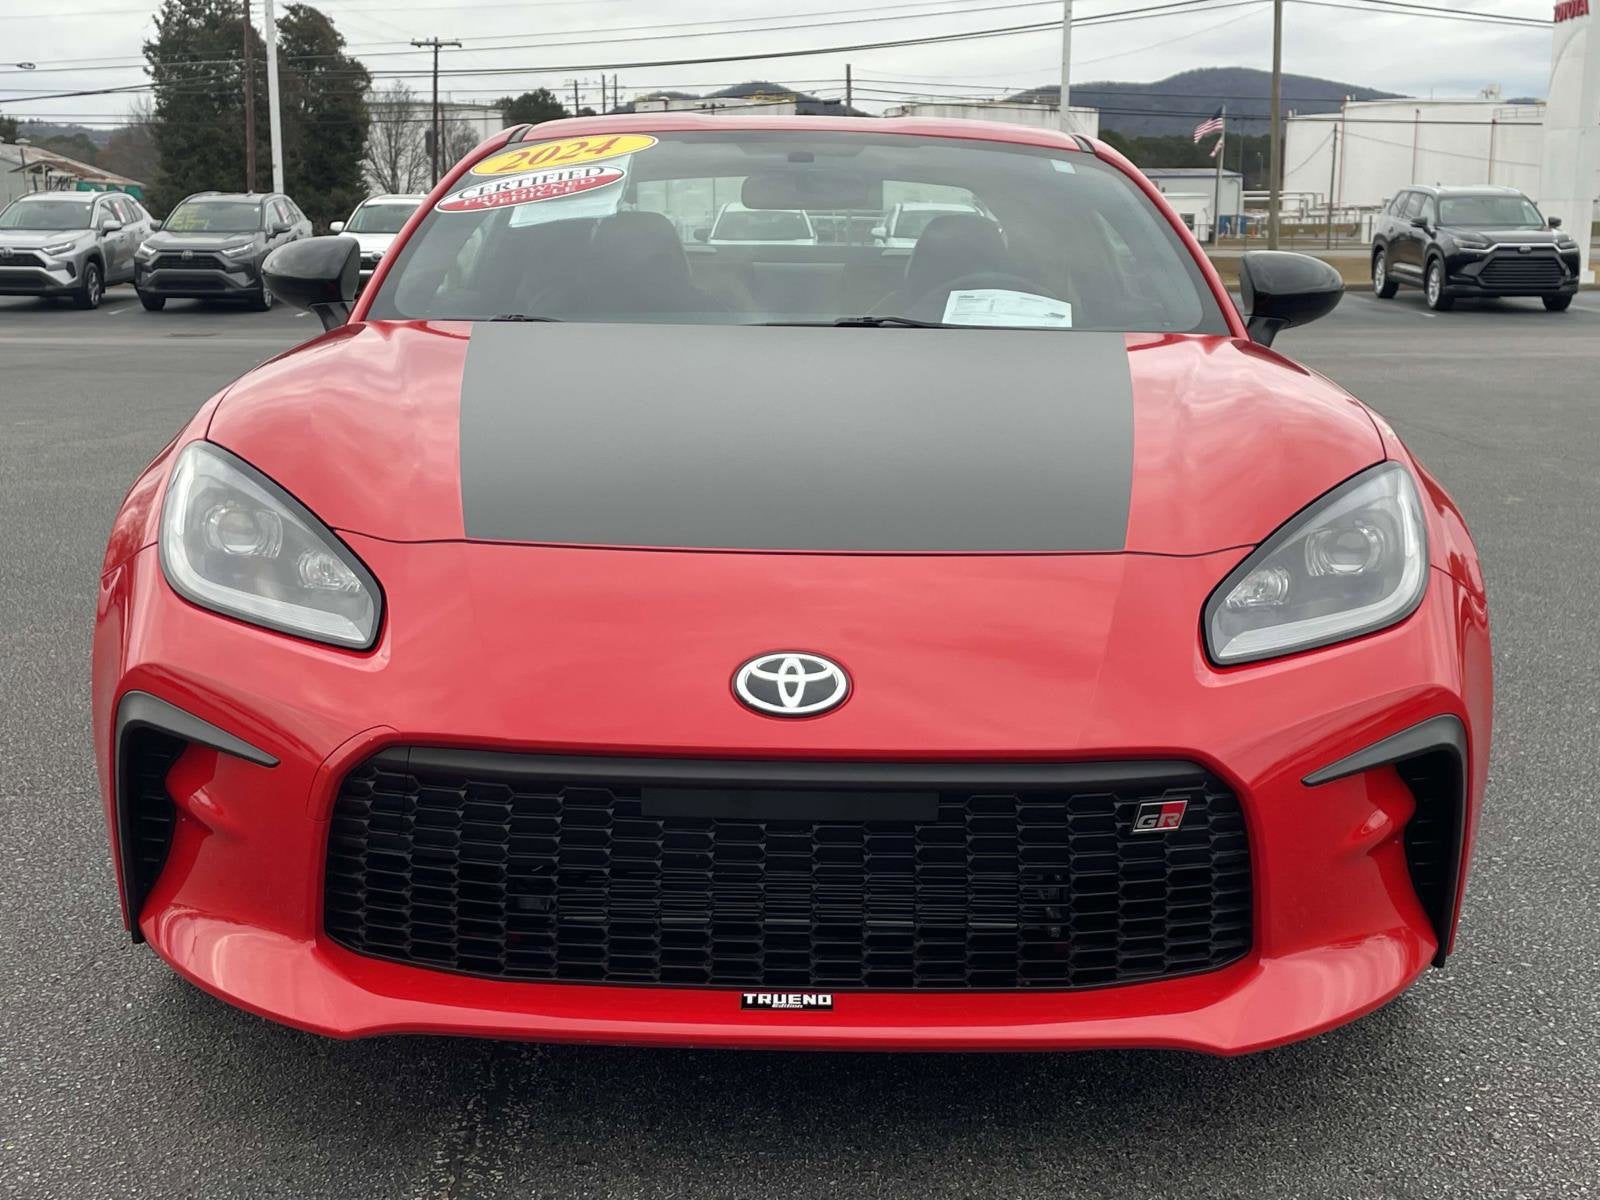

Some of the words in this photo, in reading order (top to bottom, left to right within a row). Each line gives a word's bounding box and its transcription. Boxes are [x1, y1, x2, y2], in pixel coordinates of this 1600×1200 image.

[496, 137, 622, 172] 2024
[458, 167, 605, 199] CERTIFIED
[484, 185, 577, 207] VEHICLE
[1136, 813, 1181, 829] GR
[743, 993, 832, 1005] TRUENO
